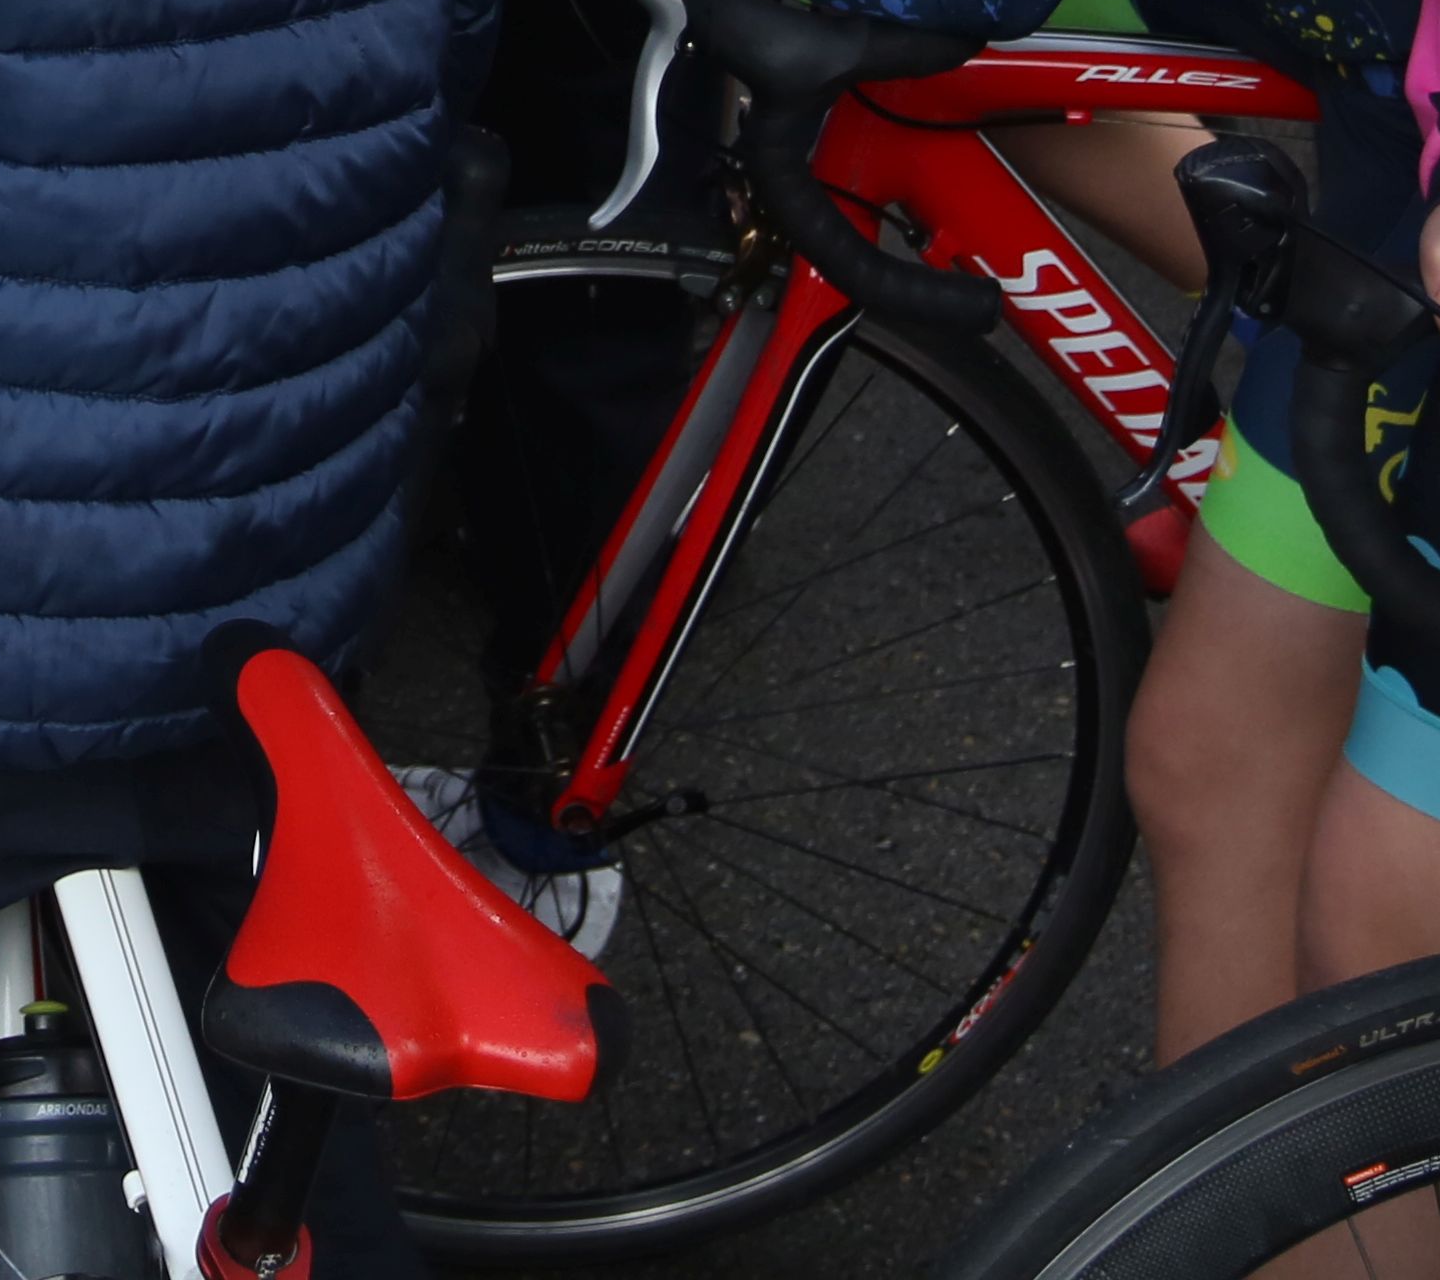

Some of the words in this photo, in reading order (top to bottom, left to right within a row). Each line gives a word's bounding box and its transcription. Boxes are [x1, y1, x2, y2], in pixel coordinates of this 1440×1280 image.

[1076, 63, 1262, 90] ALLEZ
[578, 239, 670, 256] CORSA
[36, 1102, 109, 1118] ARRIONDAS
